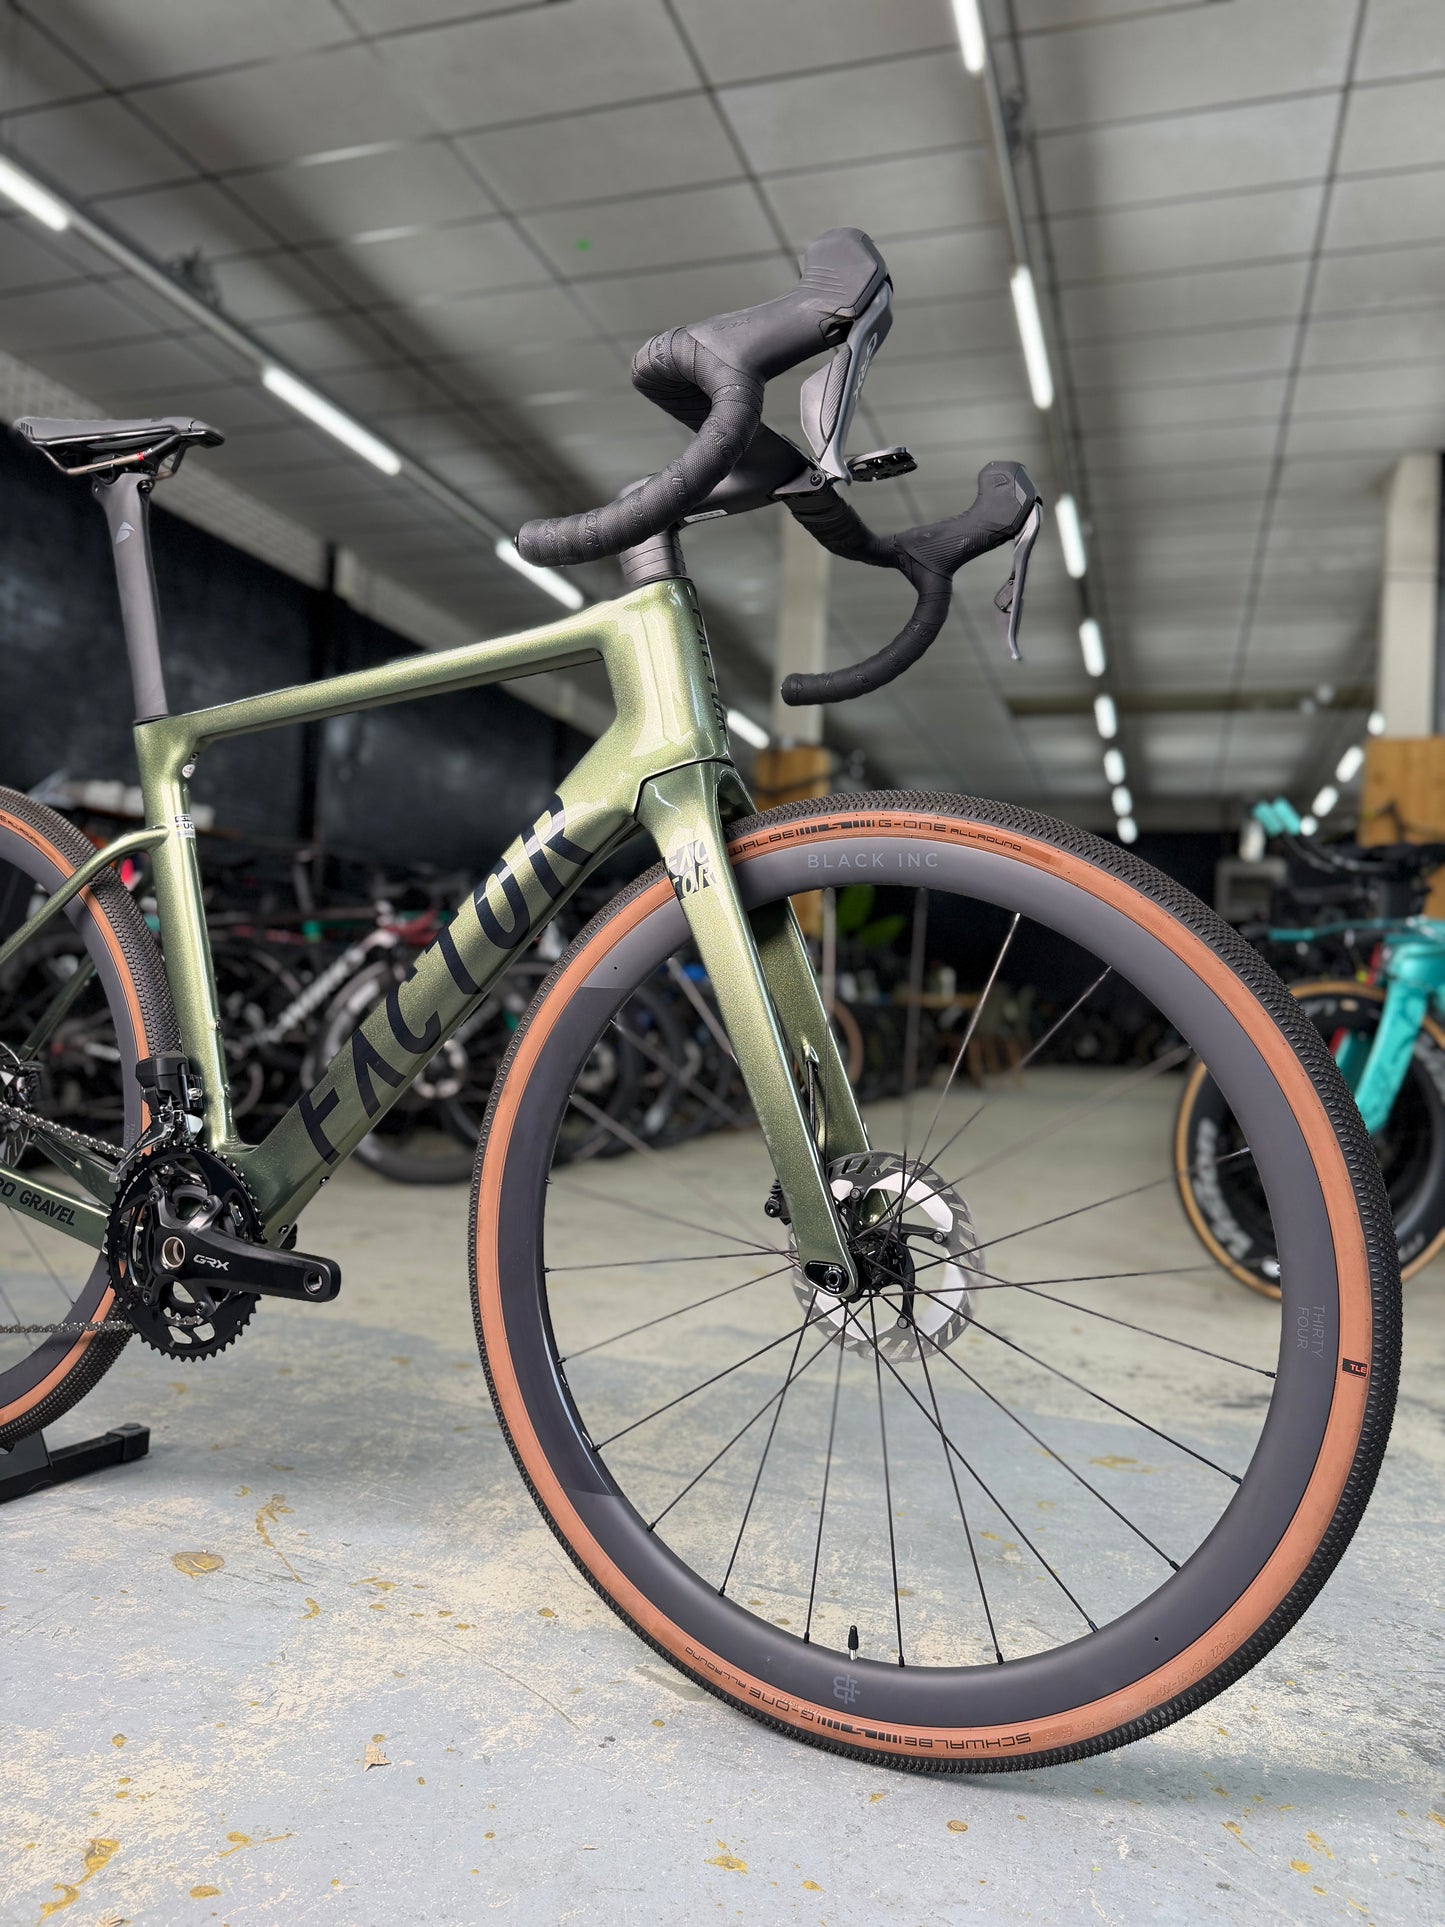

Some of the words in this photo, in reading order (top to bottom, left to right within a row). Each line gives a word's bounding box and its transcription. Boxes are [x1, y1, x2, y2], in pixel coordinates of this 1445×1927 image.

[728, 829, 795, 856] WALBE
[879, 819, 947, 833] G-ONE
[950, 828, 1022, 852] ALLROUND
[807, 852, 885, 869] BLACK
[898, 852, 939, 868] INC
[299, 793, 594, 1165] FACTOR
[19, 1190, 75, 1226] GRAVEL
[193, 1254, 230, 1272] GRX
[1296, 1306, 1310, 1350] FOUR
[1311, 1304, 1326, 1360] THIRTY
[685, 1646, 747, 1689] ALLROUND
[904, 1732, 1032, 1750] SCHWALBE
